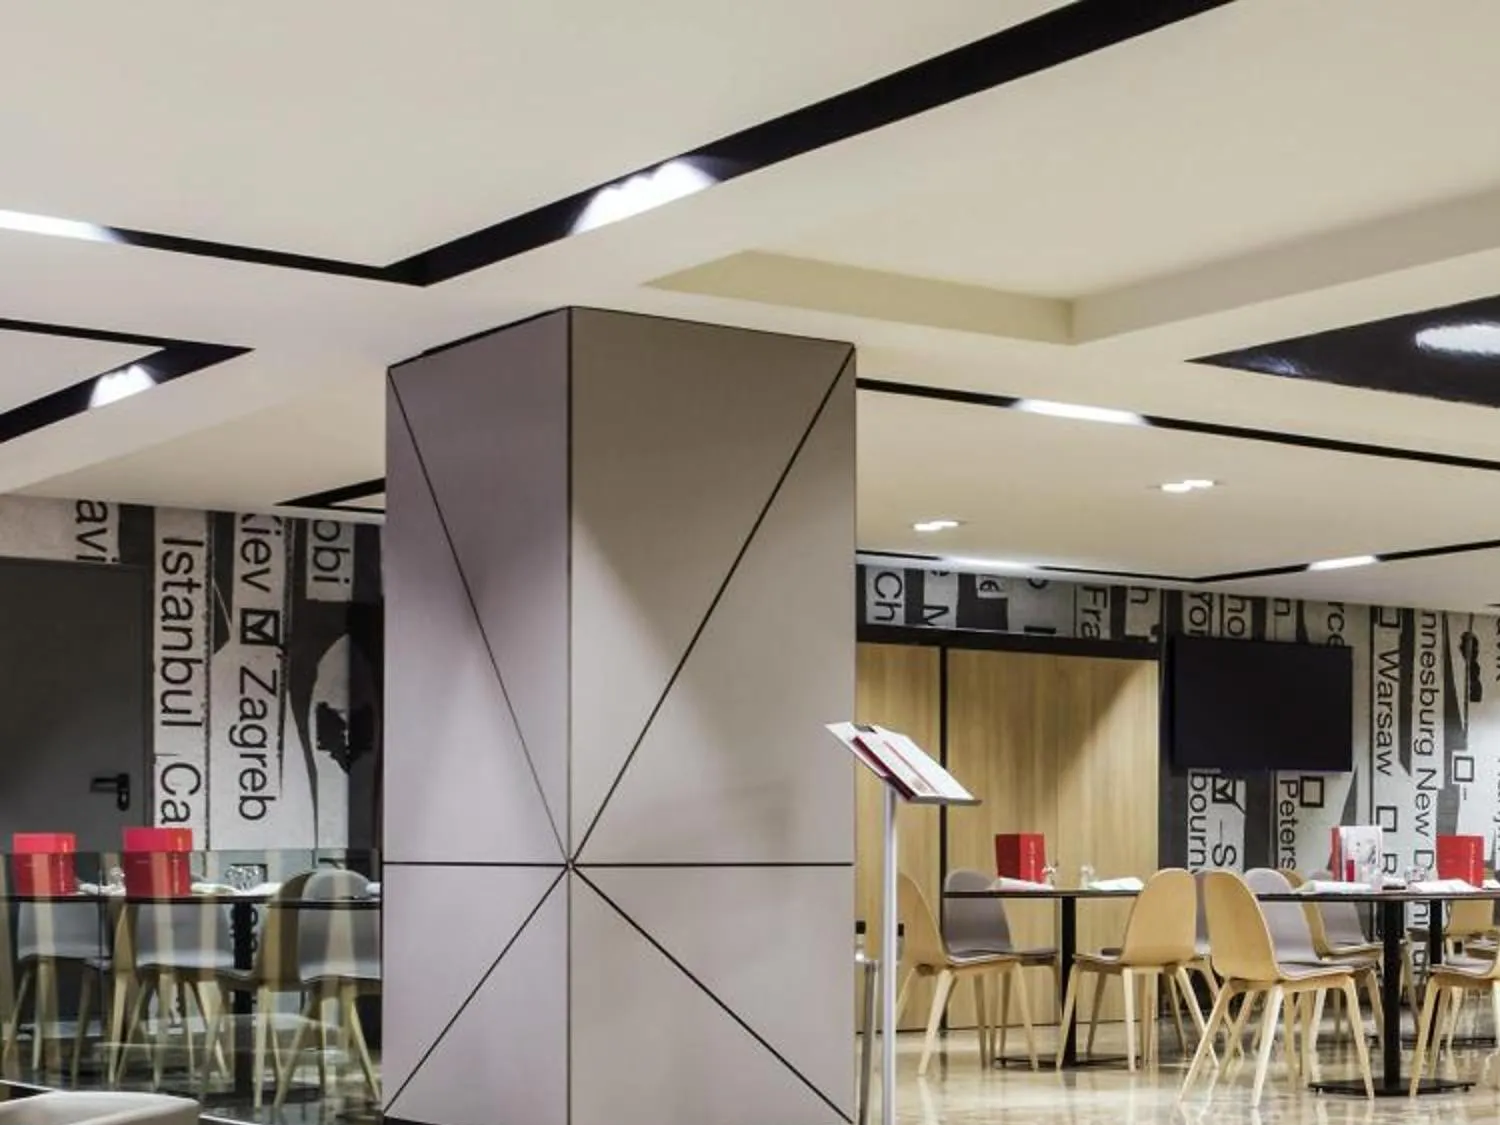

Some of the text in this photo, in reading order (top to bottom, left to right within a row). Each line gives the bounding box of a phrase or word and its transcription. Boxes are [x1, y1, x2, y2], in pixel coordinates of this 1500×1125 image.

[160, 537, 204, 727] Istanbul
[228, 665, 278, 821] Zagreb
[1376, 650, 1402, 777] Warsaw
[1189, 772, 1208, 873] bourn
[1279, 779, 1299, 871] Peters
[1414, 768, 1437, 837] New
